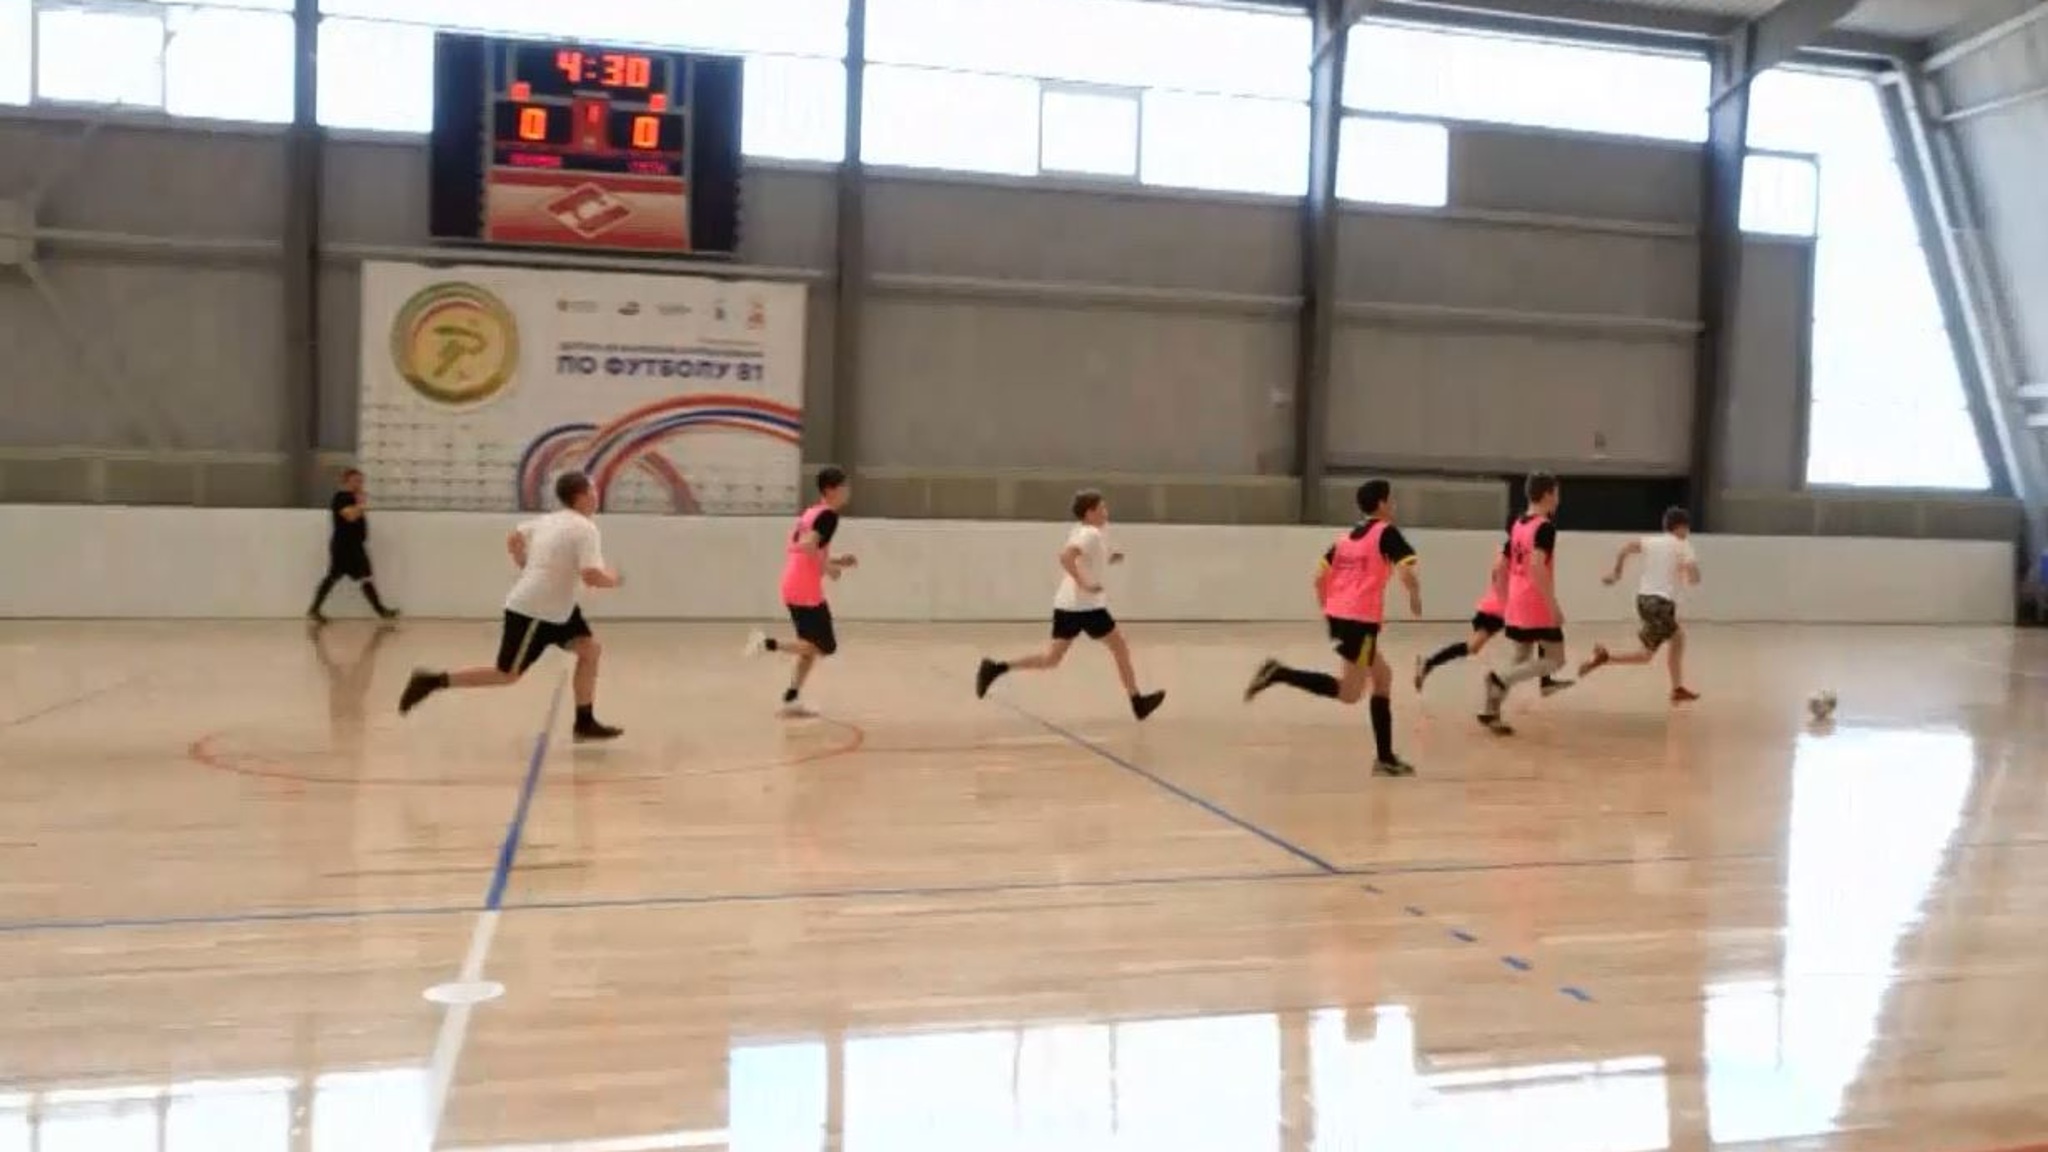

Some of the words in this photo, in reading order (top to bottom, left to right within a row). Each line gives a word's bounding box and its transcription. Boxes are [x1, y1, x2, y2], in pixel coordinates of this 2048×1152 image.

[555, 51, 651, 88] 4:30
[519, 106, 547, 140] 0
[632, 115, 660, 148] 0
[556, 354, 597, 376] ПО
[604, 356, 731, 380] ФУТБОЛУ
